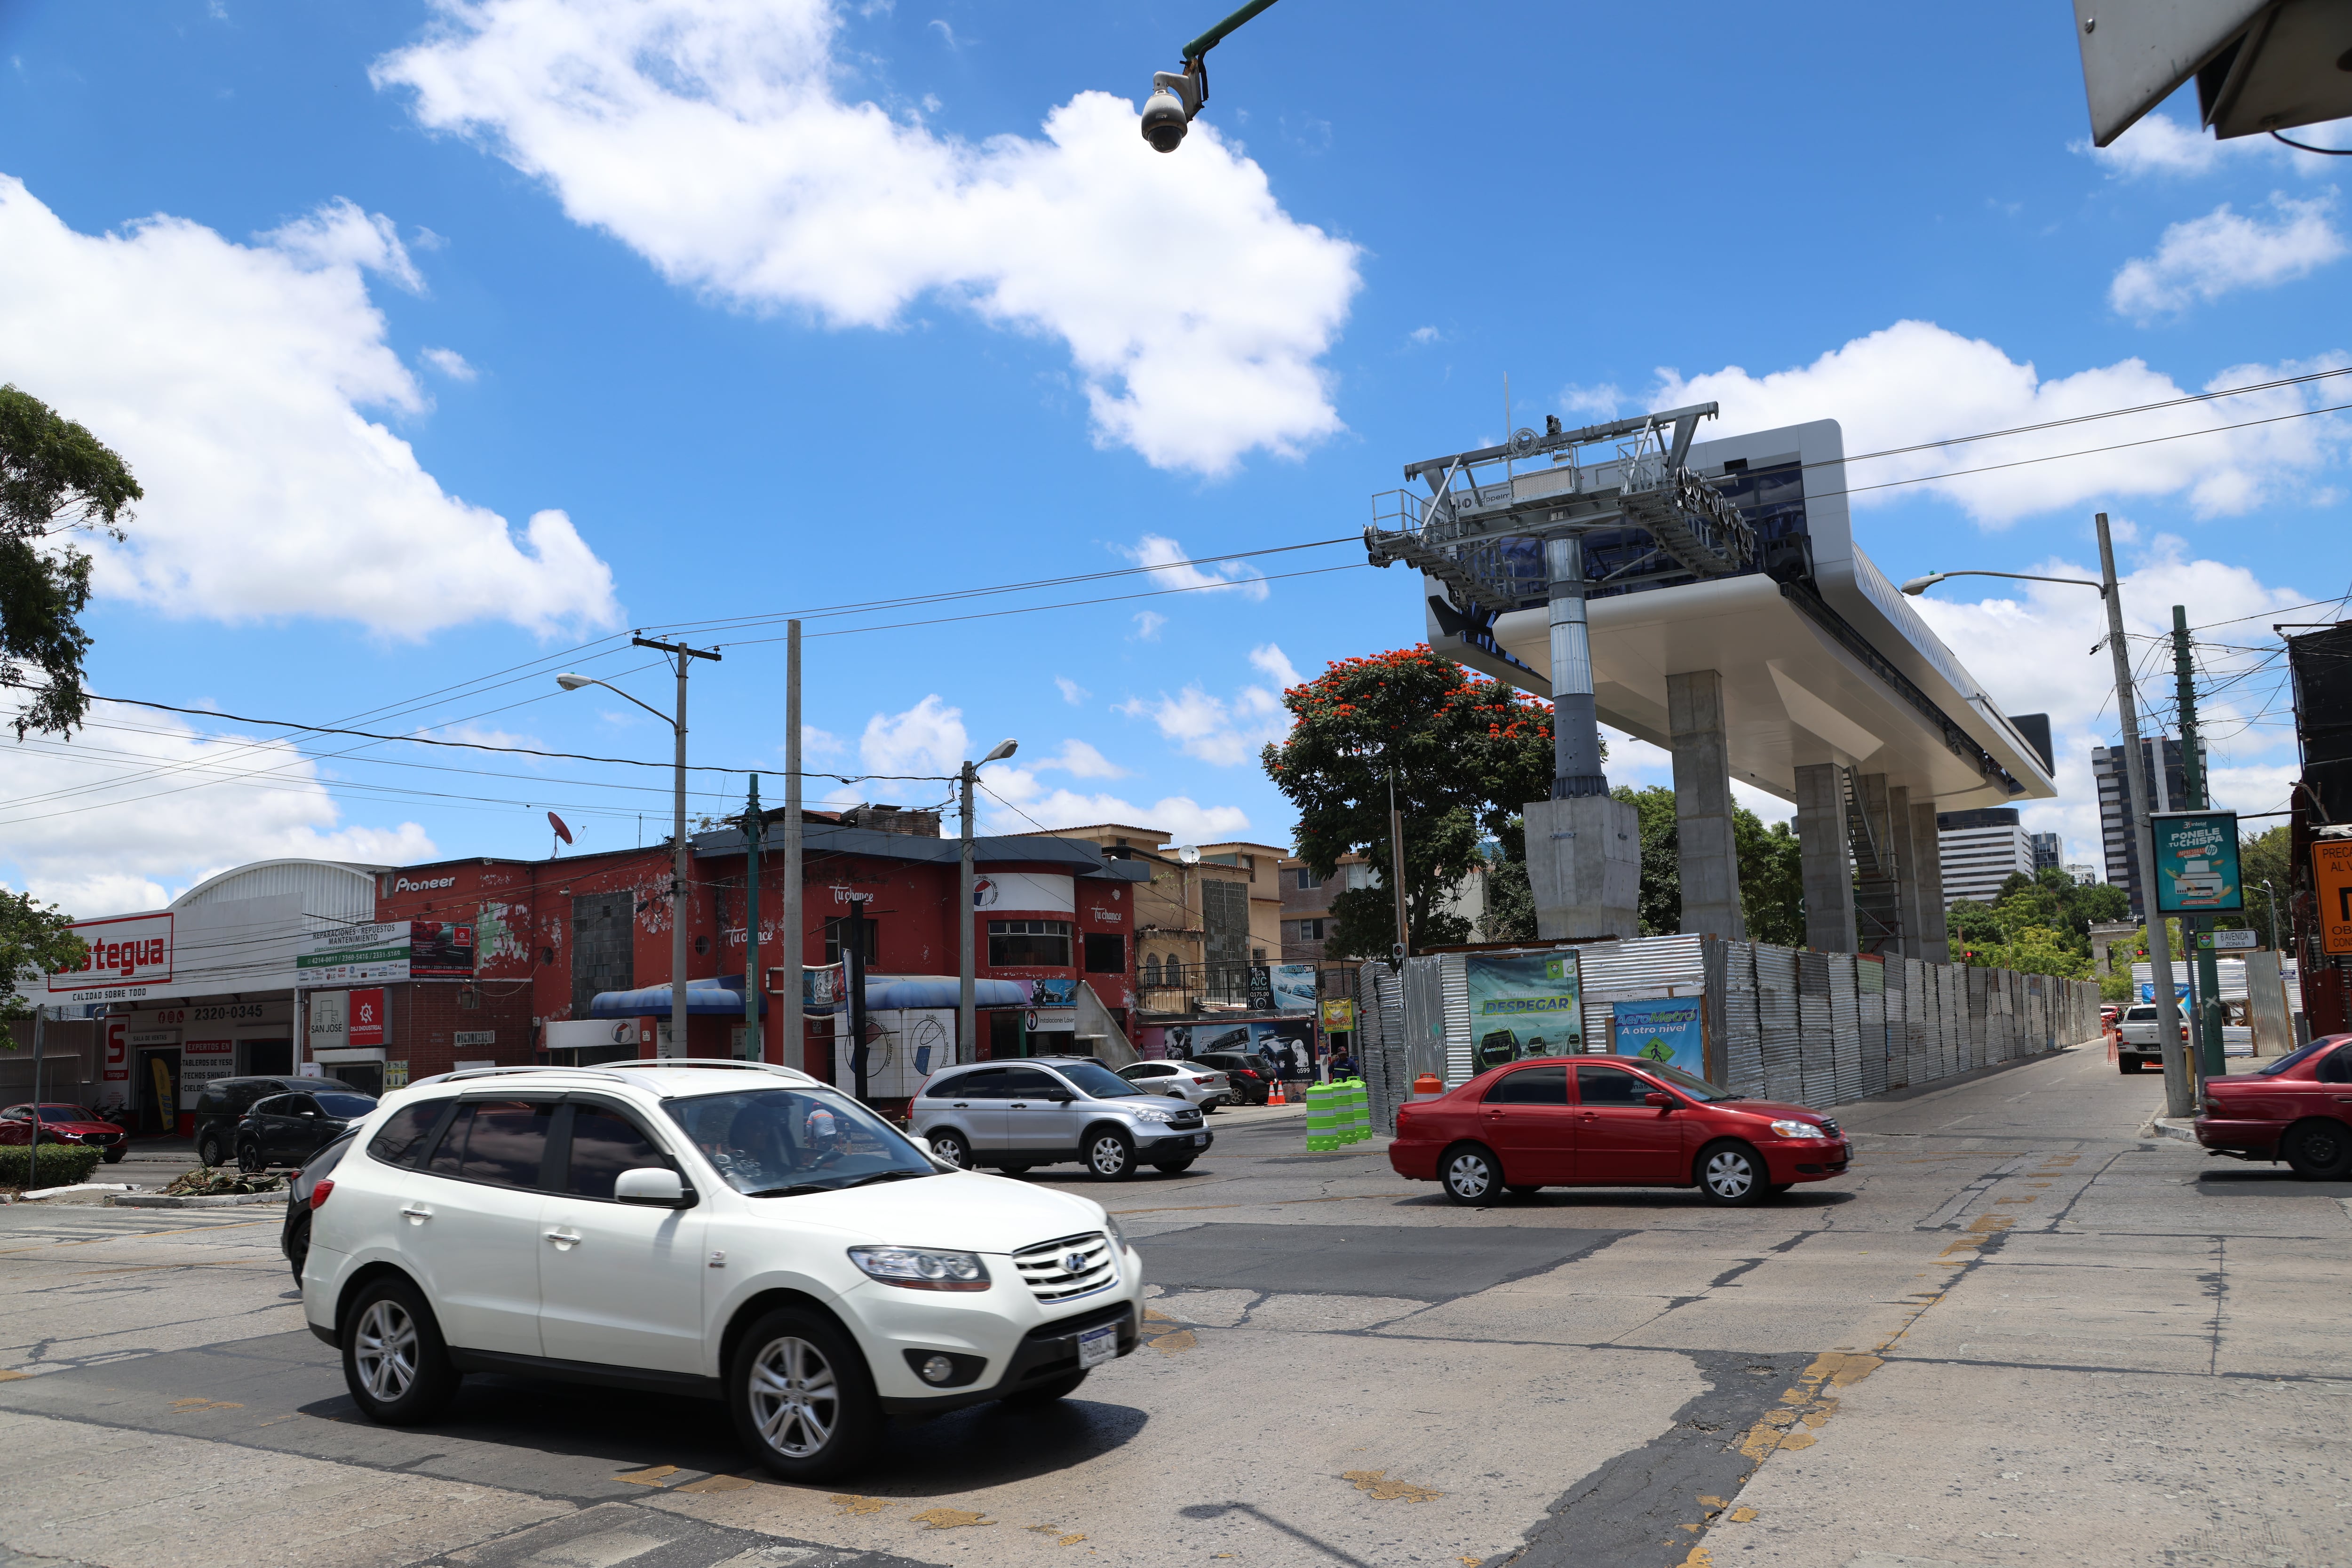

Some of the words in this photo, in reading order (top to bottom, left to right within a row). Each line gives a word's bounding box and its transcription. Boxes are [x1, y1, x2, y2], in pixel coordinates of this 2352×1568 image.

[1475, 493, 1510, 504] oppelm
[2171, 828, 2220, 841] PONELE
[2179, 835, 2224, 847] CHISPA
[2178, 848, 2205, 856] IMPRESORAS
[2206, 844, 2217, 855] hp
[2331, 861, 2344, 872] AL
[395, 877, 455, 892] Pioneer
[829, 883, 849, 904] Tu
[844, 888, 874, 902] chance
[1091, 905, 1105, 922] Tu
[1102, 908, 1121, 921] chance
[313, 928, 356, 939] REPARACIONES
[361, 924, 395, 933] REPUESTOS
[724, 926, 746, 947] Tu
[741, 928, 773, 942] cnce
[2225, 932, 2249, 941] AVENIDA
[329, 934, 378, 945] MANTENIMIENTO
[2333, 937, 2352, 947] CON
[1250, 976, 1267, 986] A/C
[73, 991, 102, 1001] CALIDAD
[105, 989, 126, 998] SOBRE
[129, 988, 146, 996] TODO
[1497, 989, 1540, 998] Estamos
[1486, 998, 1568, 1014] DESPEGAR
[195, 1005, 262, 1020] 2320-0345
[326, 1021, 342, 1032] JOSÉ
[1659, 1024, 1686, 1033] nivel
[188, 1043, 219, 1051] EXPERTOS
